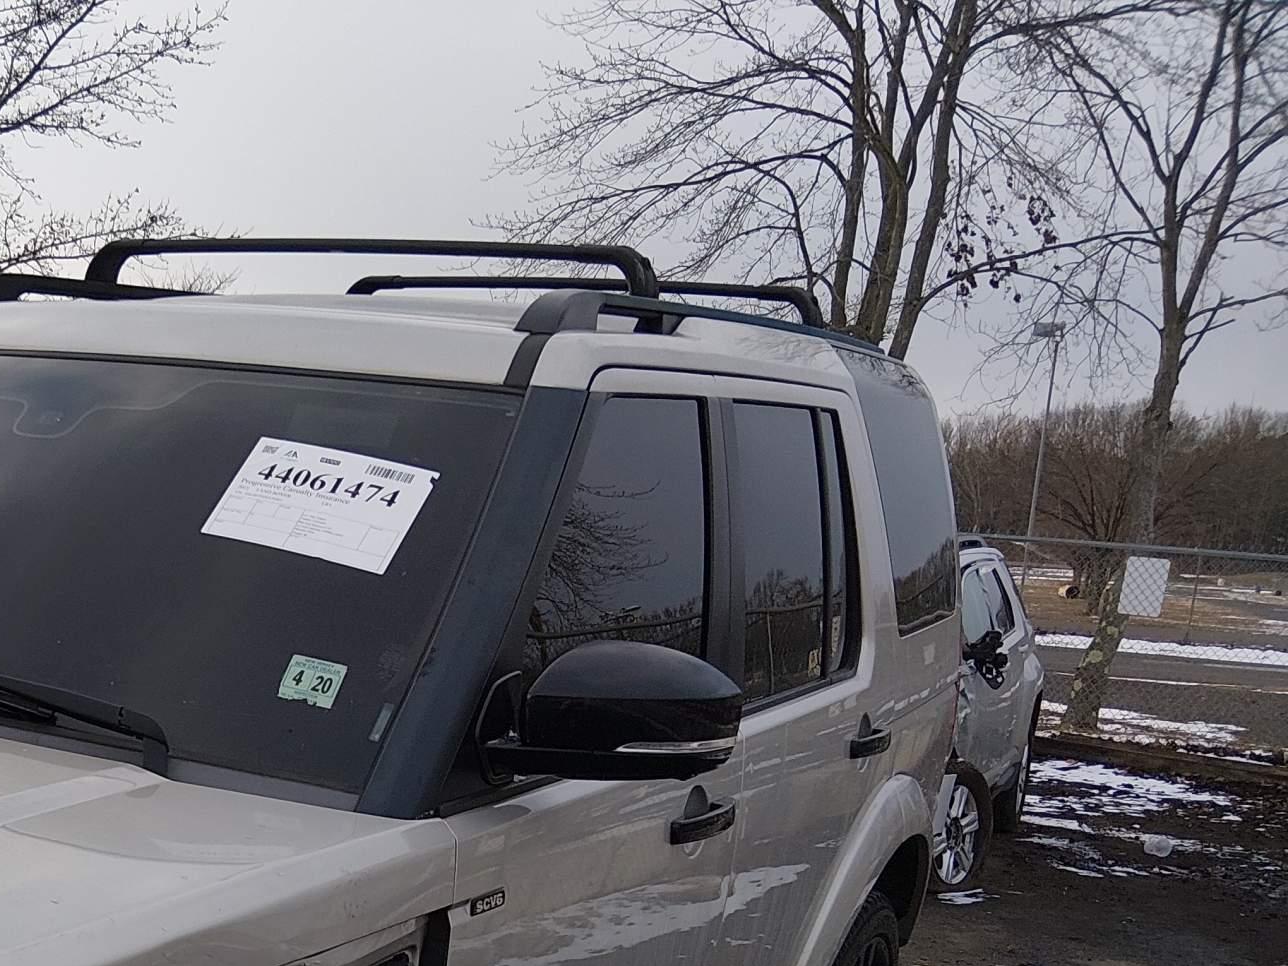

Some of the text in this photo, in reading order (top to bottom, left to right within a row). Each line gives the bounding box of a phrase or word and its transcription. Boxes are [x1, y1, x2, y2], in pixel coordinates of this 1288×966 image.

[258, 463, 401, 508] 44061474
[292, 669, 305, 686] 4
[310, 675, 333, 694] 20
[476, 893, 503, 913] SCV6
